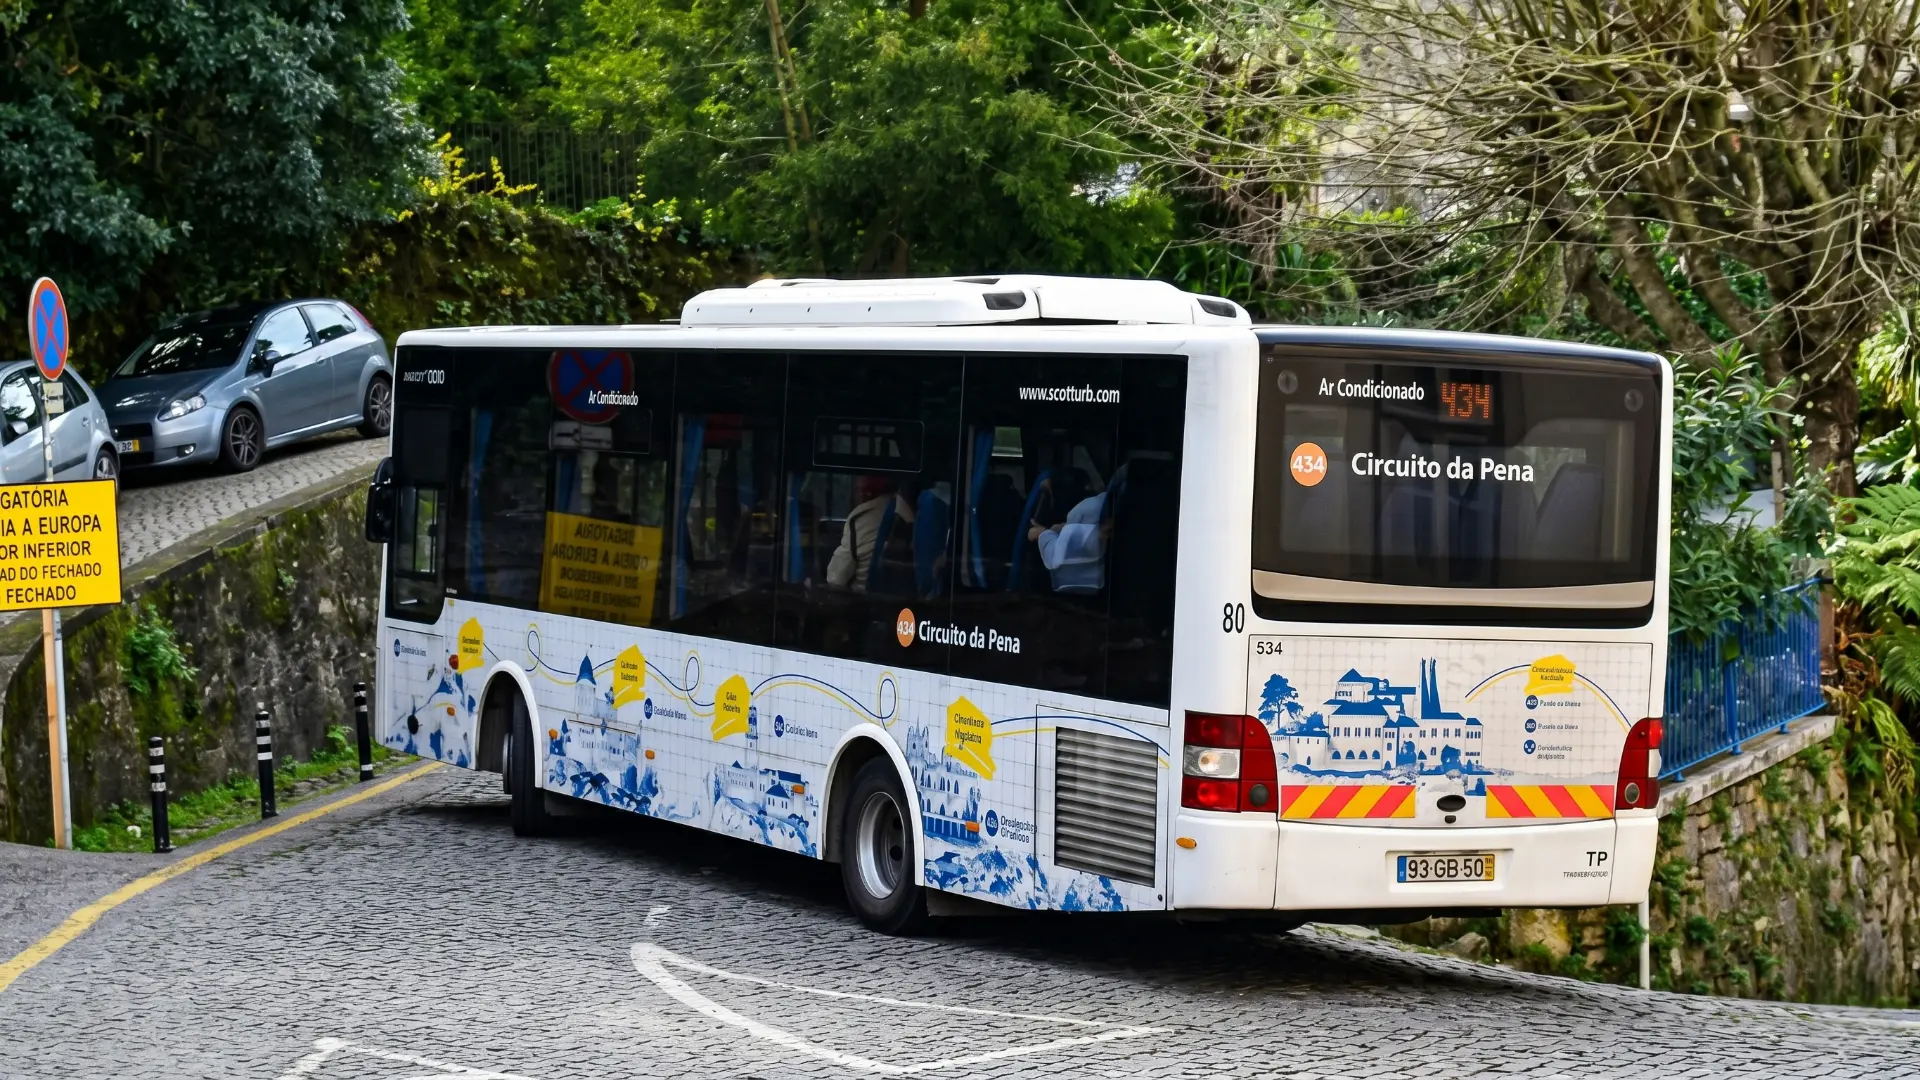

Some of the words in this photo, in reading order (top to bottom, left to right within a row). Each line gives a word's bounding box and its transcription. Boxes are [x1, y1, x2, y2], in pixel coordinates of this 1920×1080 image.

[588, 389, 597, 405] Ar
[1019, 383, 1120, 403] www.scotturb.com
[1319, 378, 1334, 396] Ar
[1337, 379, 1425, 401] Condicionado
[1441, 382, 1490, 419] 434
[1292, 455, 1325, 473] 434
[1351, 452, 1441, 478] Circuito
[1446, 455, 1474, 479] da
[1480, 457, 1534, 482] Pena
[22, 518, 33, 536] A
[39, 514, 102, 535] EUROPA
[23, 540, 92, 559] INFERIOR
[20, 566, 38, 581] DO
[42, 562, 102, 579] FECHADO
[6, 585, 76, 604] FECHADO
[1222, 602, 1245, 633] 80
[897, 621, 915, 636] 434
[918, 620, 967, 647] Circuito
[969, 625, 985, 649] da
[988, 628, 1020, 654] Pena
[1256, 641, 1283, 655] 534
[1586, 851, 1608, 867] TP
